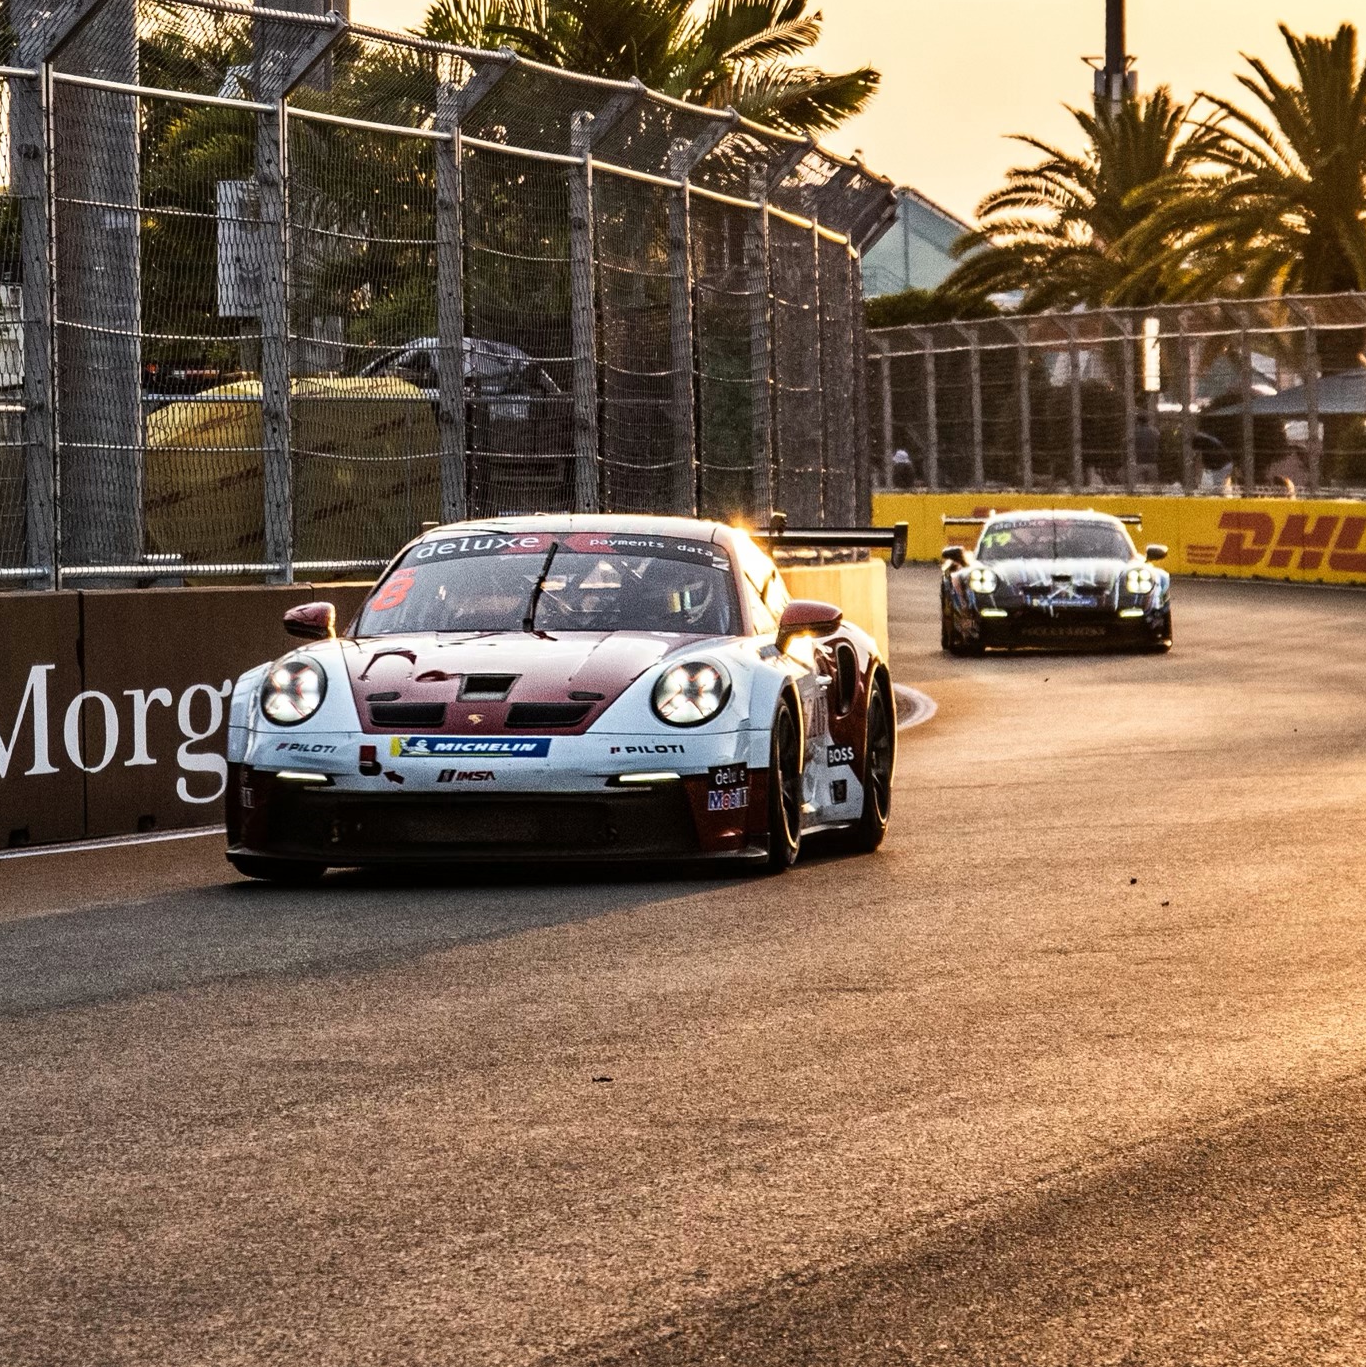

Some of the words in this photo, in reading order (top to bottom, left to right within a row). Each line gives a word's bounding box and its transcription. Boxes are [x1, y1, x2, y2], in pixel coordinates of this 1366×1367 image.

[984, 530, 1012, 548] 19
[416, 536, 540, 559] deluxe
[589, 538, 666, 550] payments
[677, 543, 714, 557] data
[371, 577, 415, 611] 8
[287, 743, 337, 754] PILOTI
[434, 742, 539, 752] MICHELIN
[625, 744, 685, 754] PILOTI
[828, 745, 855, 761] BOSS
[455, 770, 497, 782] IMSA
[714, 767, 746, 785] delue
